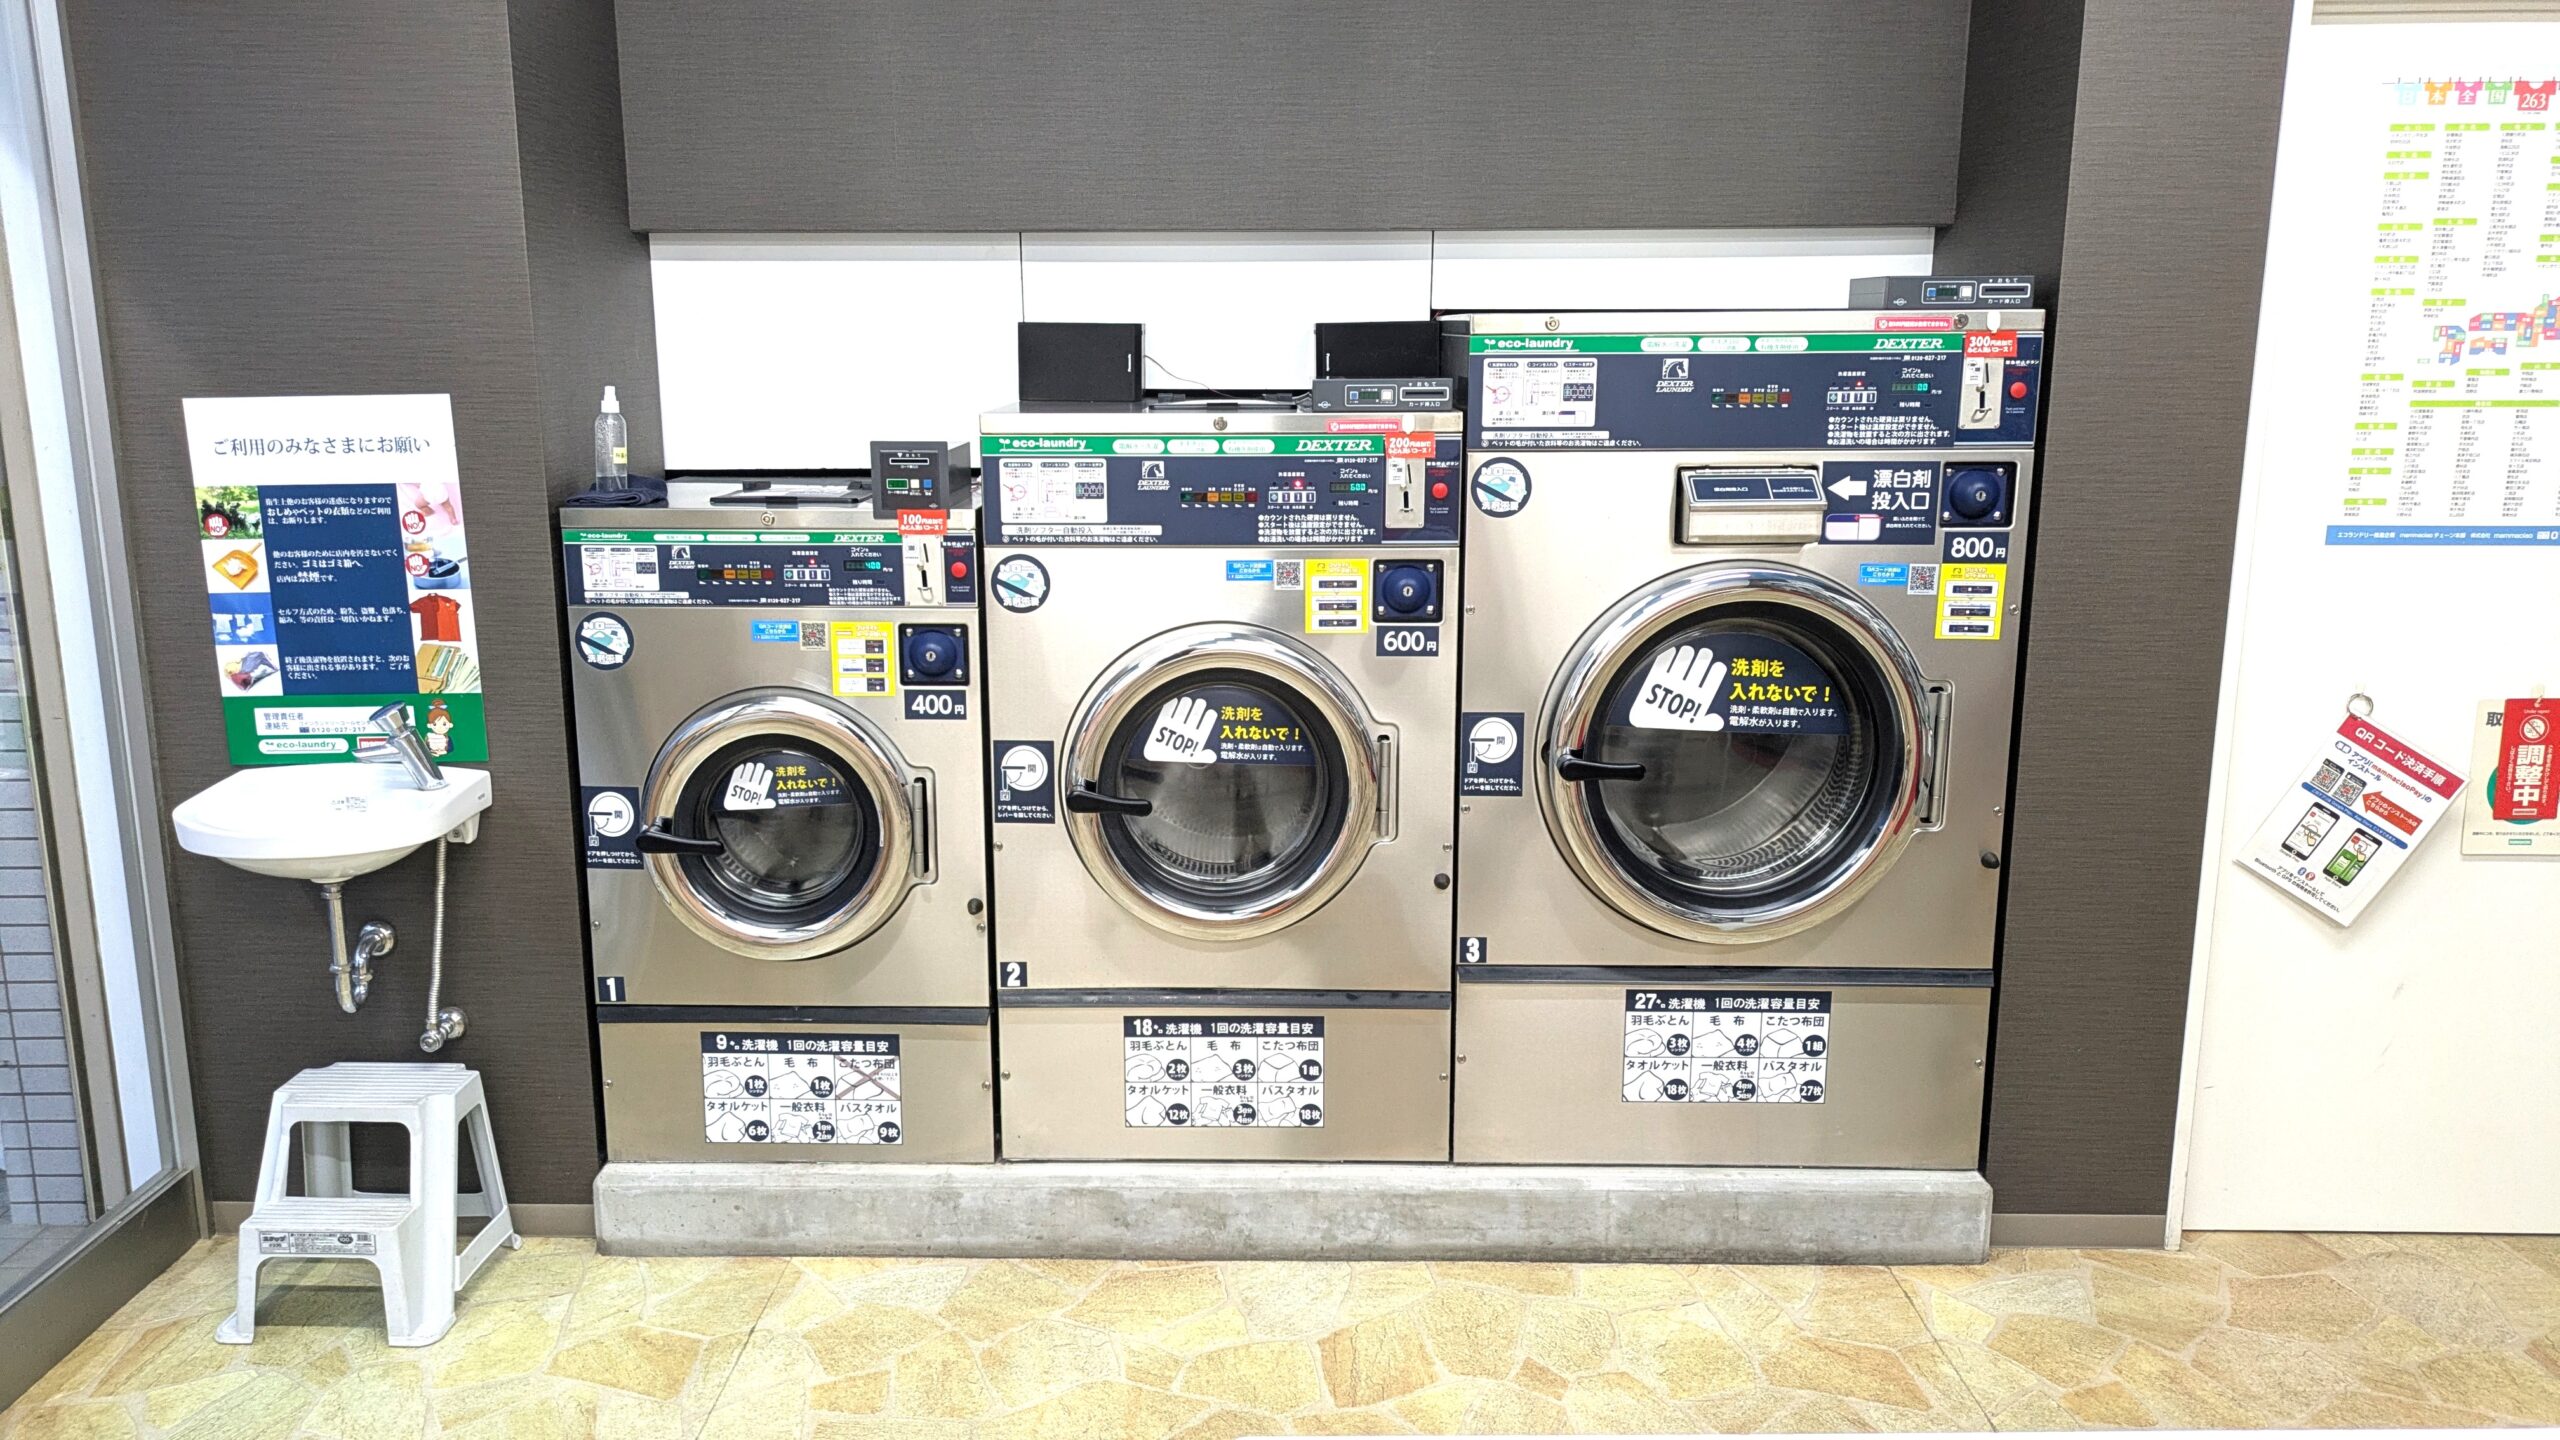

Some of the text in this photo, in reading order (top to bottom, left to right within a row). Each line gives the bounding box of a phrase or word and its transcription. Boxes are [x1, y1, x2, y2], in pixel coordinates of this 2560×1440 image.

[2460, 90, 2476, 104] 全
[2521, 93, 2546, 109] 263
[1498, 338, 1574, 350] eco-laundry
[1873, 338, 1945, 350] DEXTER
[213, 437, 430, 456] ご利用のみなさまにお願い
[1012, 438, 1087, 450] eco-laundry
[1295, 440, 1375, 452] DEXTER
[1872, 469, 1932, 489] 漂白剤
[1871, 492, 1930, 510] 投入口
[833, 534, 884, 543] DEXTER
[1951, 537, 2006, 558] 800円
[1384, 631, 1437, 652] 600円
[1731, 658, 1785, 678] 洗剤を
[1729, 683, 1831, 702] 入れないで！
[911, 694, 965, 715] 400円
[1646, 684, 1702, 723] STOP!
[263, 712, 304, 721] 管理責任者
[1220, 706, 1263, 721] 洗剤を
[1729, 704, 1838, 717] 洗剤・柔軟剤は自動で入ります。
[264, 722, 289, 731] 連絡先
[1729, 716, 1801, 728] 電解水が入ります。
[1220, 725, 1300, 740] 入れないで！
[276, 740, 336, 750] eco-laundry
[1156, 726, 1199, 757] STOP!
[775, 765, 807, 777] 洗剤を
[2348, 758, 2382, 782] インストール
[2512, 744, 2546, 807] 調整中
[776, 778, 837, 791] 入れないで！
[731, 784, 762, 806] STOP!
[1466, 938, 1479, 963] 3
[1006, 962, 1021, 988] 2
[604, 978, 617, 1002] 1
[1715, 998, 1821, 1010] 1回の洗濯容量目安
[1631, 1015, 1690, 1026] 羽毛ぶとん
[1765, 1016, 1825, 1027] こたつ布団
[1210, 1022, 1314, 1035] 1回の洗濯容量目安
[786, 1038, 889, 1053] 1回の洗濯容量目安
[1129, 1040, 1188, 1051] 羽毛ぶとん
[1262, 1040, 1319, 1051] こたつ布団
[1668, 1038, 1688, 1048] 3枚
[1736, 1038, 1756, 1049] 4枚
[1805, 1040, 1824, 1051] 1組
[707, 1056, 765, 1068] 羽毛ぶとん
[838, 1058, 895, 1069] こたつ布団
[1626, 1060, 1689, 1071] タオルケット
[1701, 1060, 1748, 1071] 一般衣料
[1763, 1061, 1822, 1071] バスタオル
[1168, 1063, 1187, 1074] 2枚
[1235, 1063, 1254, 1074] 3枚
[1301, 1065, 1320, 1076] 1組
[747, 1078, 765, 1089] 1枚
[813, 1079, 831, 1090] 1枚
[1666, 1084, 1687, 1095] 18枚
[1128, 1085, 1189, 1095] タオルケット
[1201, 1085, 1247, 1095] 一般衣料
[1262, 1085, 1320, 1095] バスタオル
[1801, 1085, 1822, 1096] 27枚
[706, 1101, 769, 1112] タオルケット
[780, 1102, 825, 1112] 一般衣料
[840, 1103, 897, 1113] バスタオル
[1168, 1108, 1188, 1120] 12枚
[1300, 1109, 1321, 1120] 18枚
[748, 1125, 767, 1137] 6枚
[880, 1126, 899, 1138] 9枚
